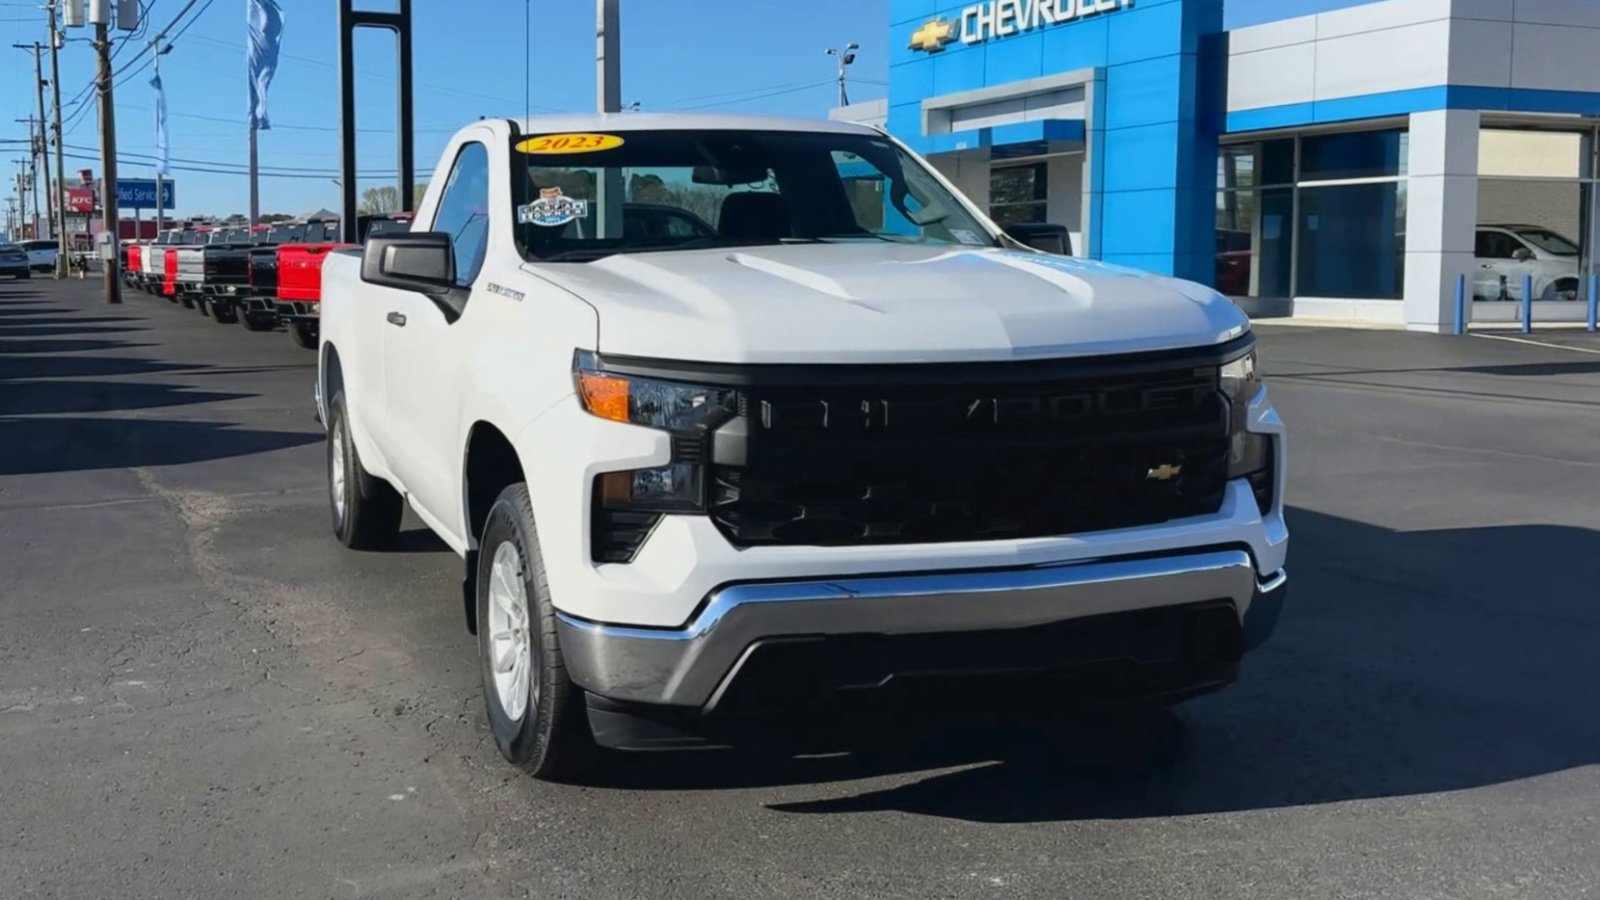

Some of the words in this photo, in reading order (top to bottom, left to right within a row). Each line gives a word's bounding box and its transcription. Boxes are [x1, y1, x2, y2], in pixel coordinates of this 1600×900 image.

[960, 0, 1130, 44] CHEVROL
[532, 136, 604, 151] 2023
[71, 196, 92, 205] KFC
